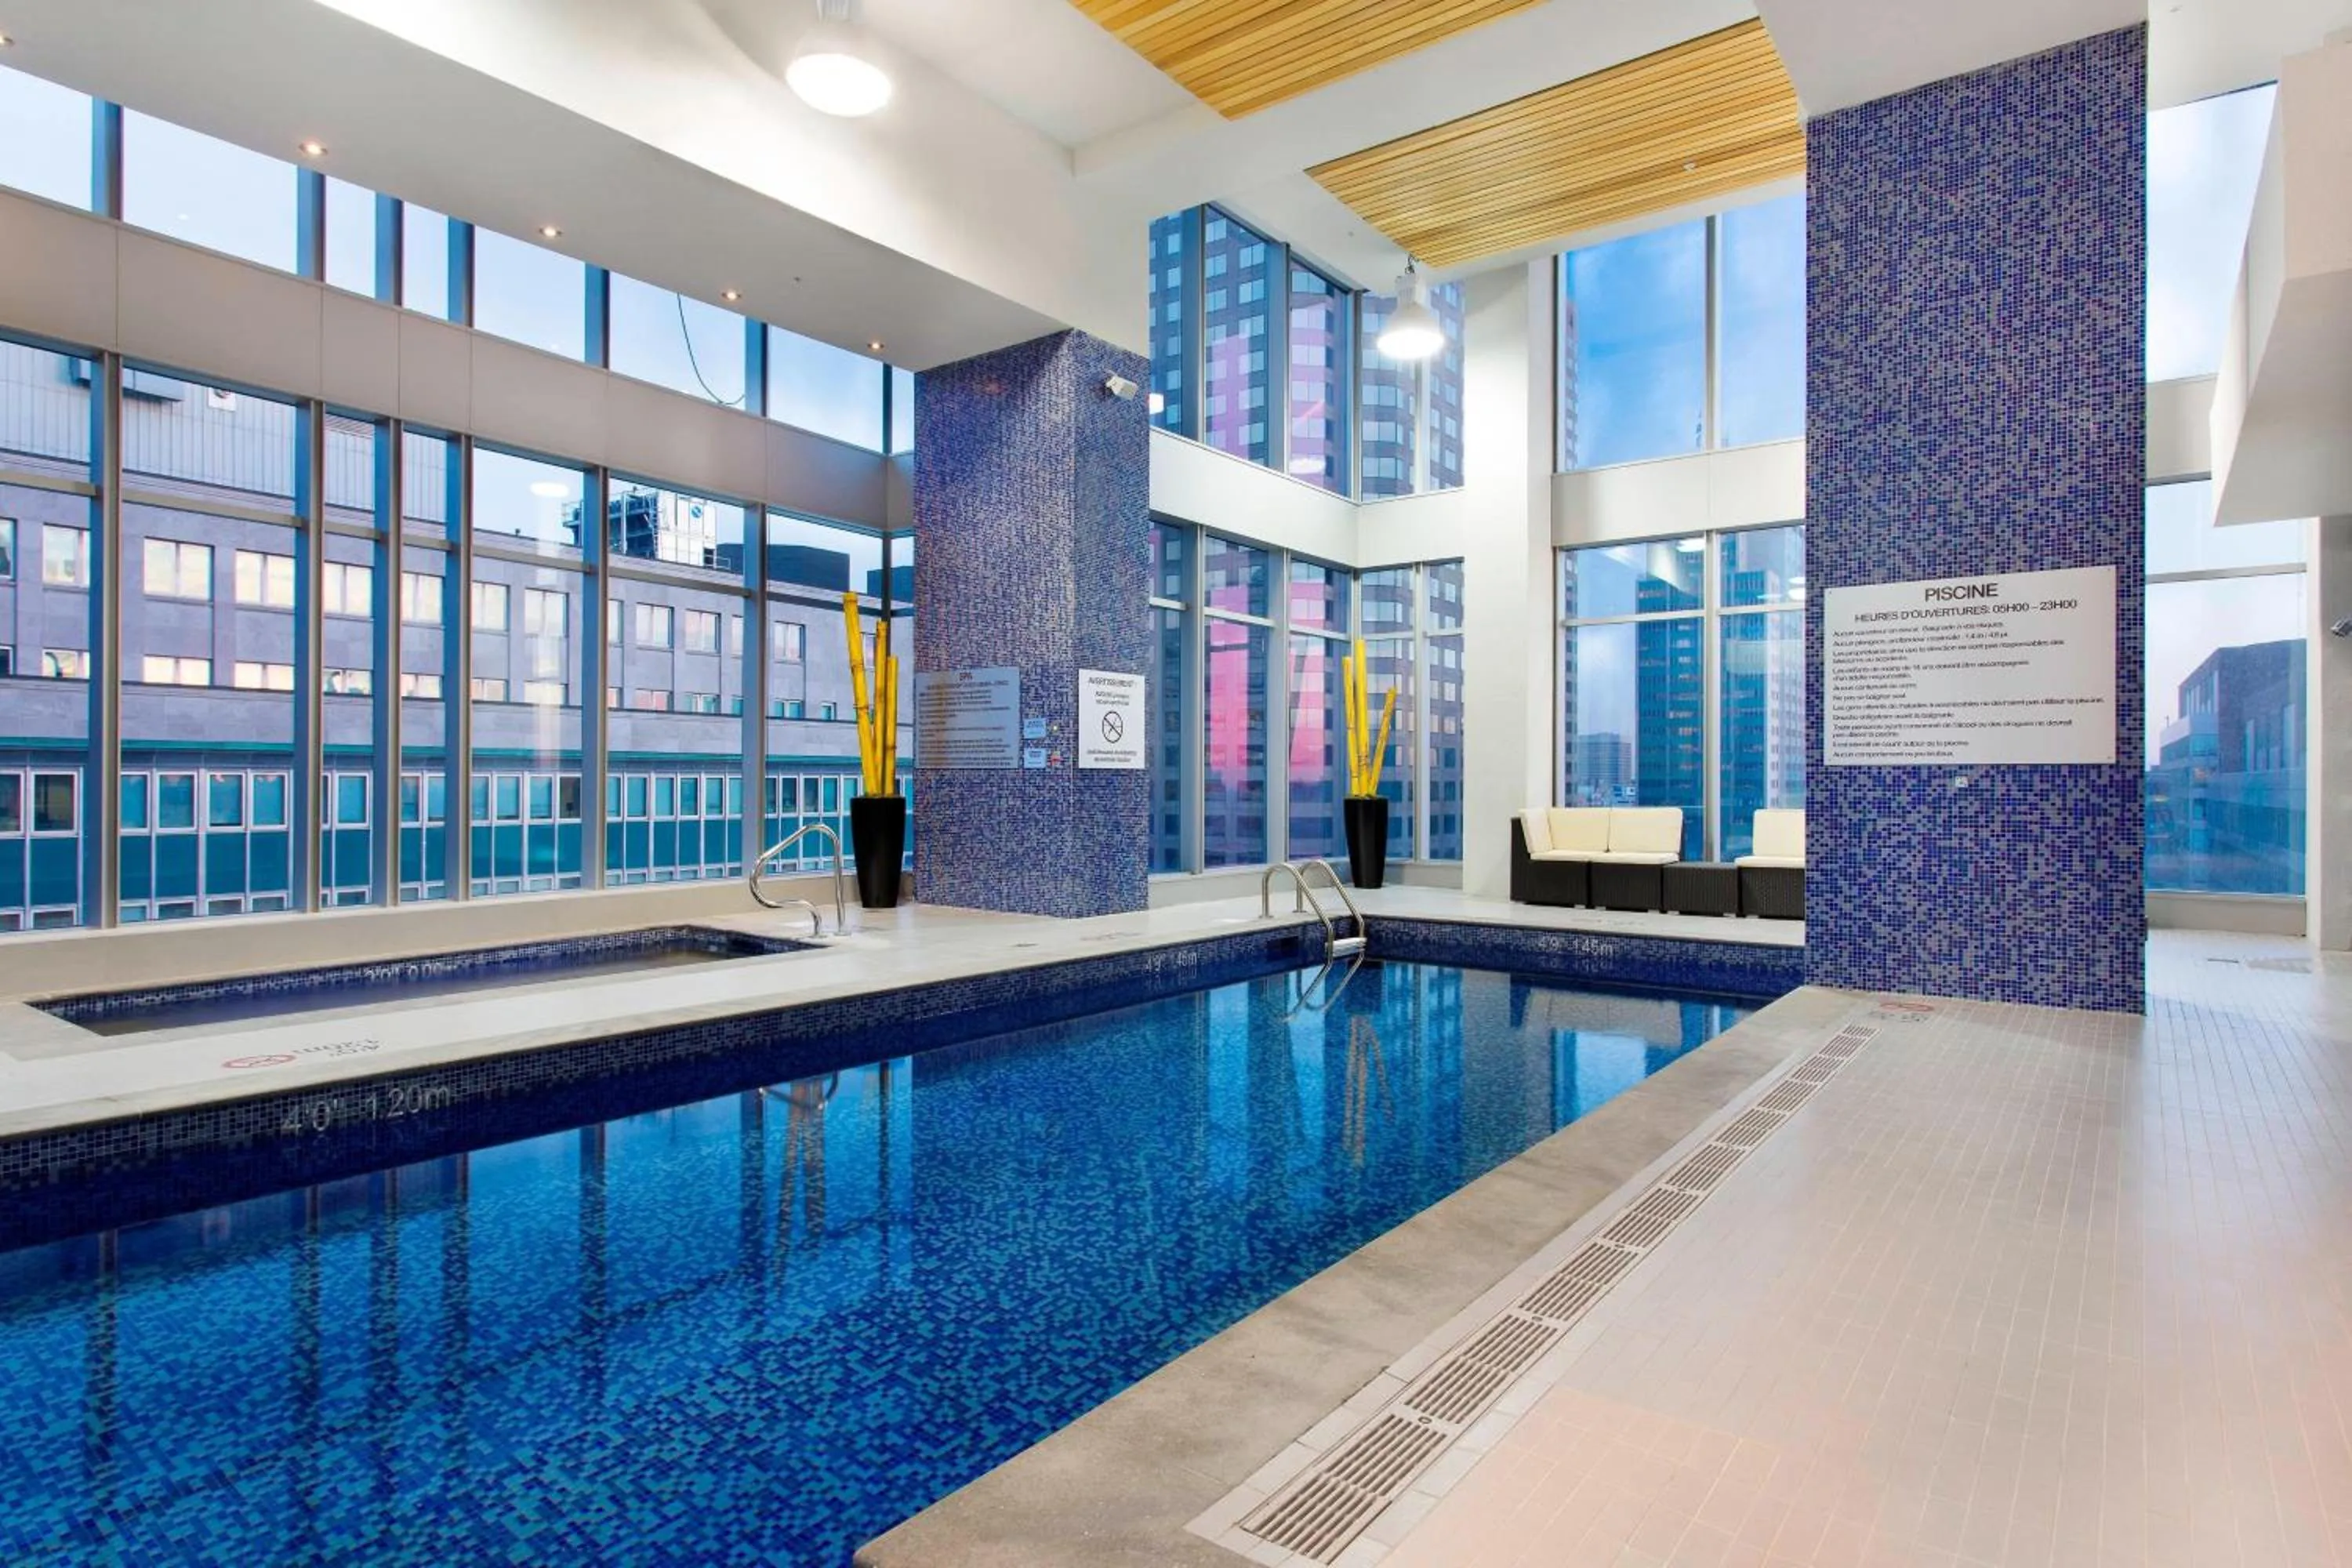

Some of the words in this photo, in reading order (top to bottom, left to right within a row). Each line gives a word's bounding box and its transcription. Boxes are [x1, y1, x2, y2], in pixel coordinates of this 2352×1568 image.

[1925, 583, 1998, 602] PISCINE
[1854, 612, 1898, 622] HEURES
[1992, 602, 2030, 614] 05H00
[2040, 599, 2078, 612] 23H00
